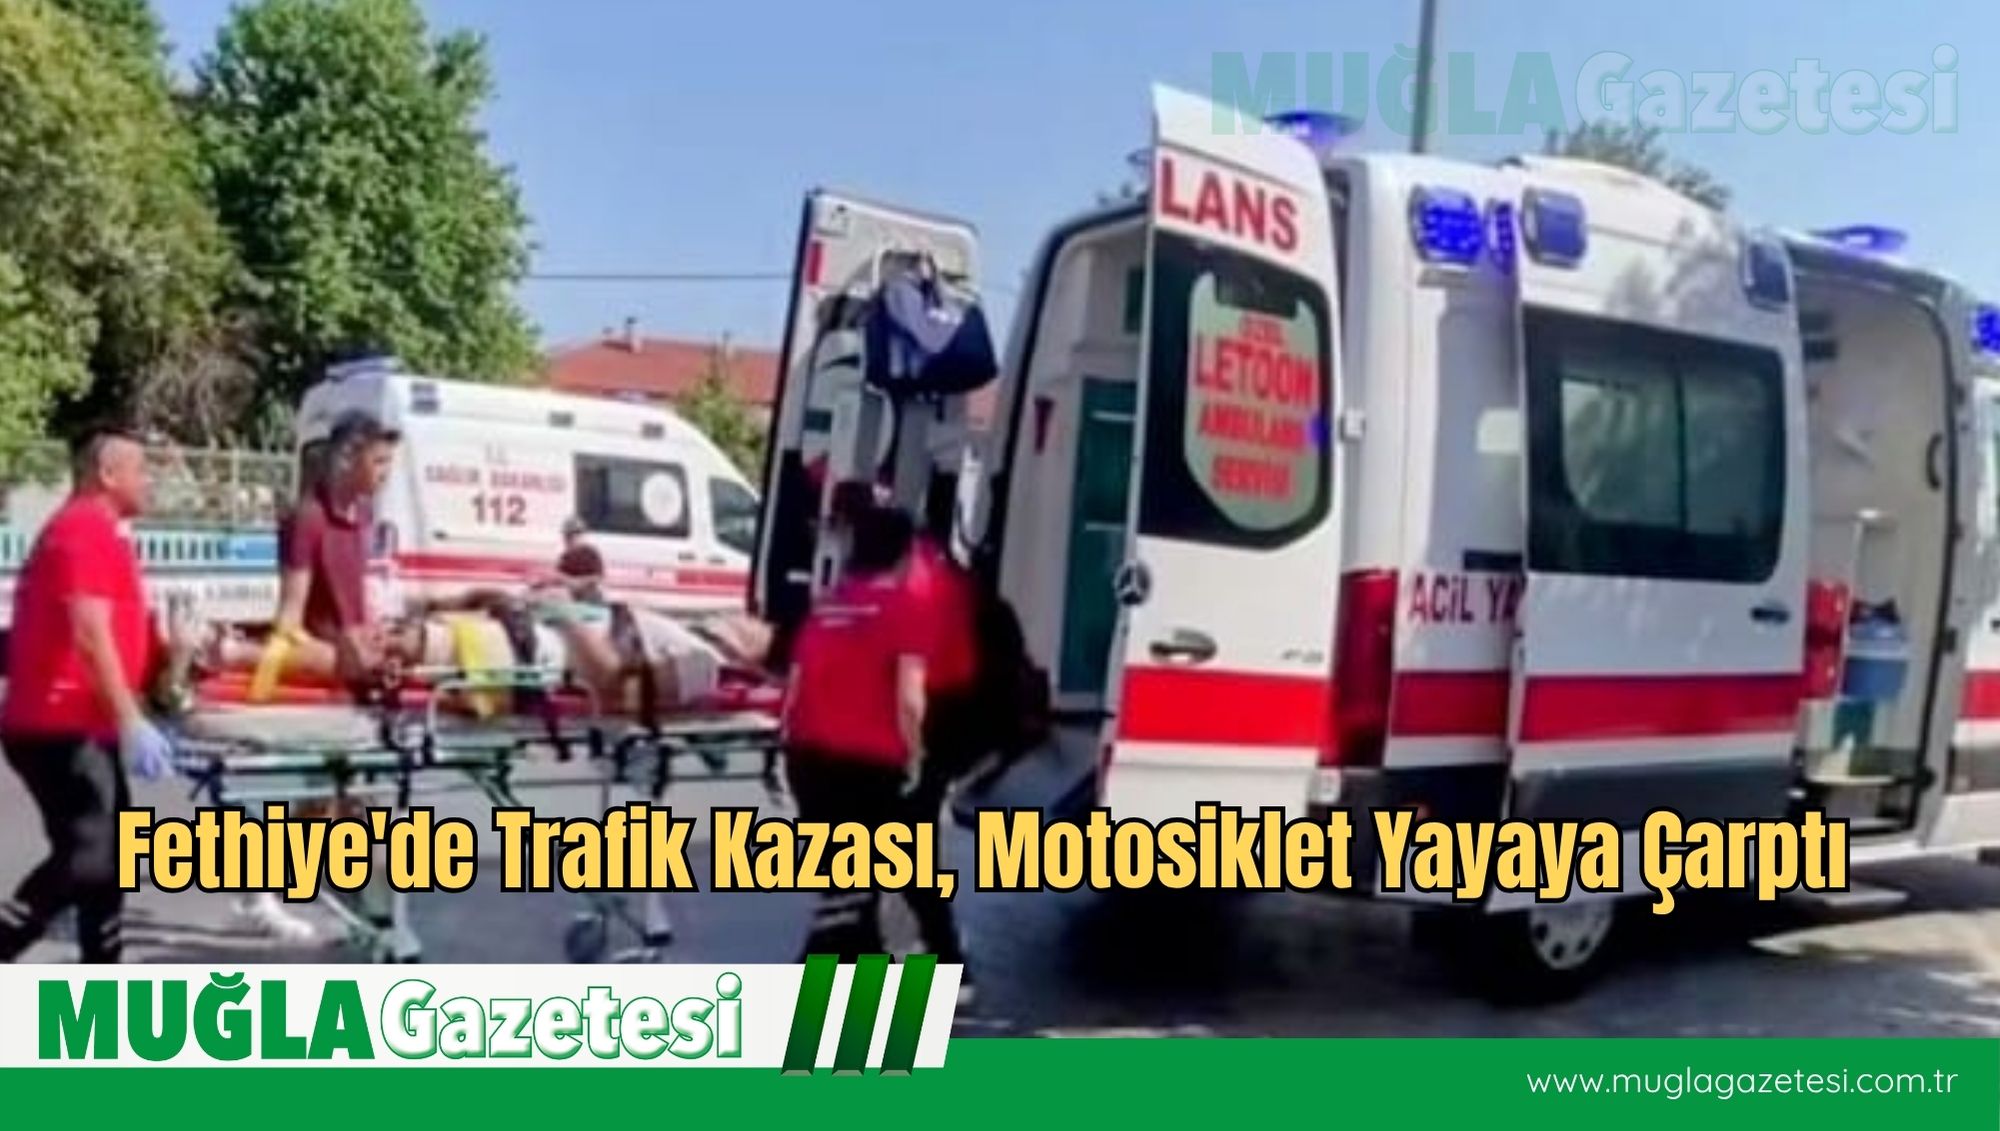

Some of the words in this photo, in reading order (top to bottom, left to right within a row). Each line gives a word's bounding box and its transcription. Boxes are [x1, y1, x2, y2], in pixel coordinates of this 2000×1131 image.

[1162, 157, 1297, 254] LANS
[471, 493, 527, 526] 112
[1408, 572, 1474, 625] ACİL
